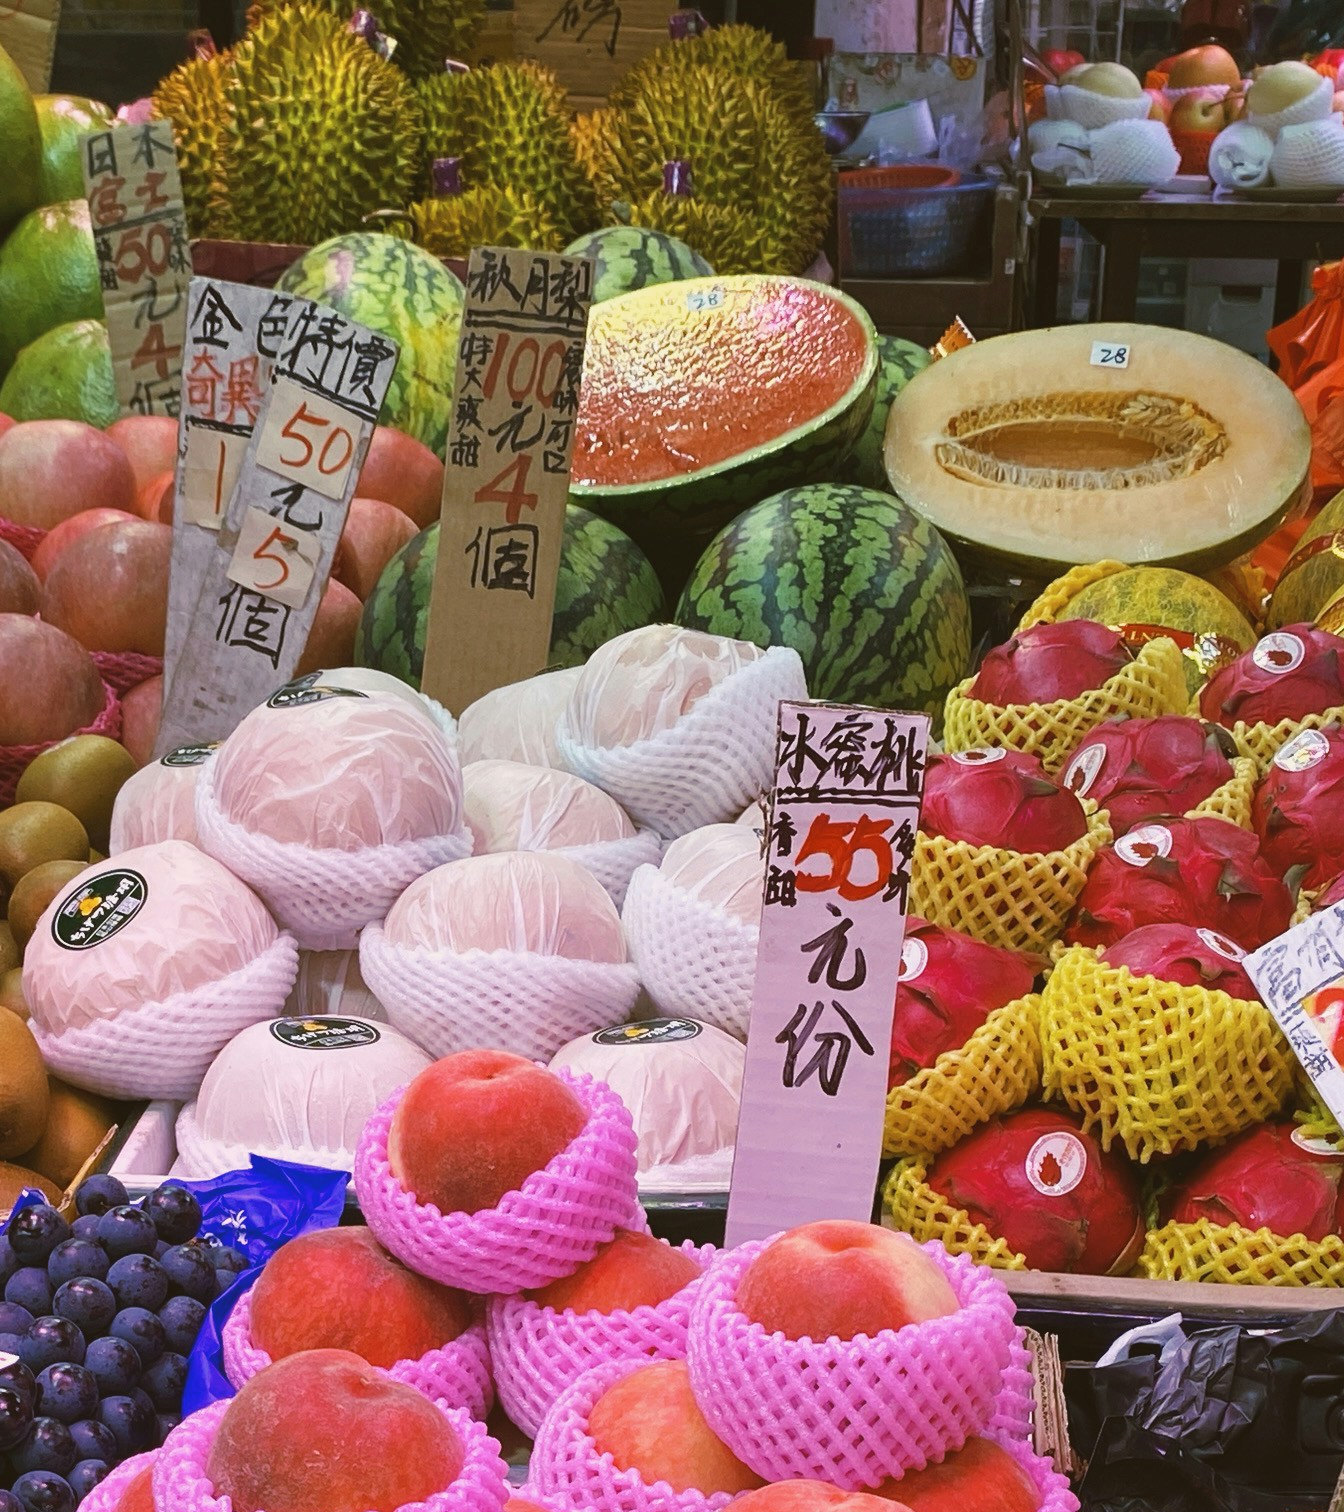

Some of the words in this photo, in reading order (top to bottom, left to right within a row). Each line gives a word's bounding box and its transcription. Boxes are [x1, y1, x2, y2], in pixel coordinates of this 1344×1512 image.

[86, 124, 175, 179] 日本
[114, 223, 172, 285] 50
[466, 250, 591, 329] 秋月梨
[130, 273, 183, 330] 元
[692, 293, 720, 311] 28
[130, 323, 183, 381] 4
[185, 346, 274, 427] 奇異
[280, 300, 396, 406] 特價
[481, 331, 570, 409] 100
[1101, 347, 1128, 365] 28
[279, 401, 354, 478] 50
[487, 400, 547, 455] 元
[473, 452, 540, 526] 4
[252, 525, 291, 590] 5
[464, 523, 541, 601] 個
[216, 582, 292, 671] 個
[779, 710, 926, 796] 水蜜桃
[794, 812, 893, 903] 55
[800, 902, 866, 991] 元
[775, 999, 876, 1097] 份
